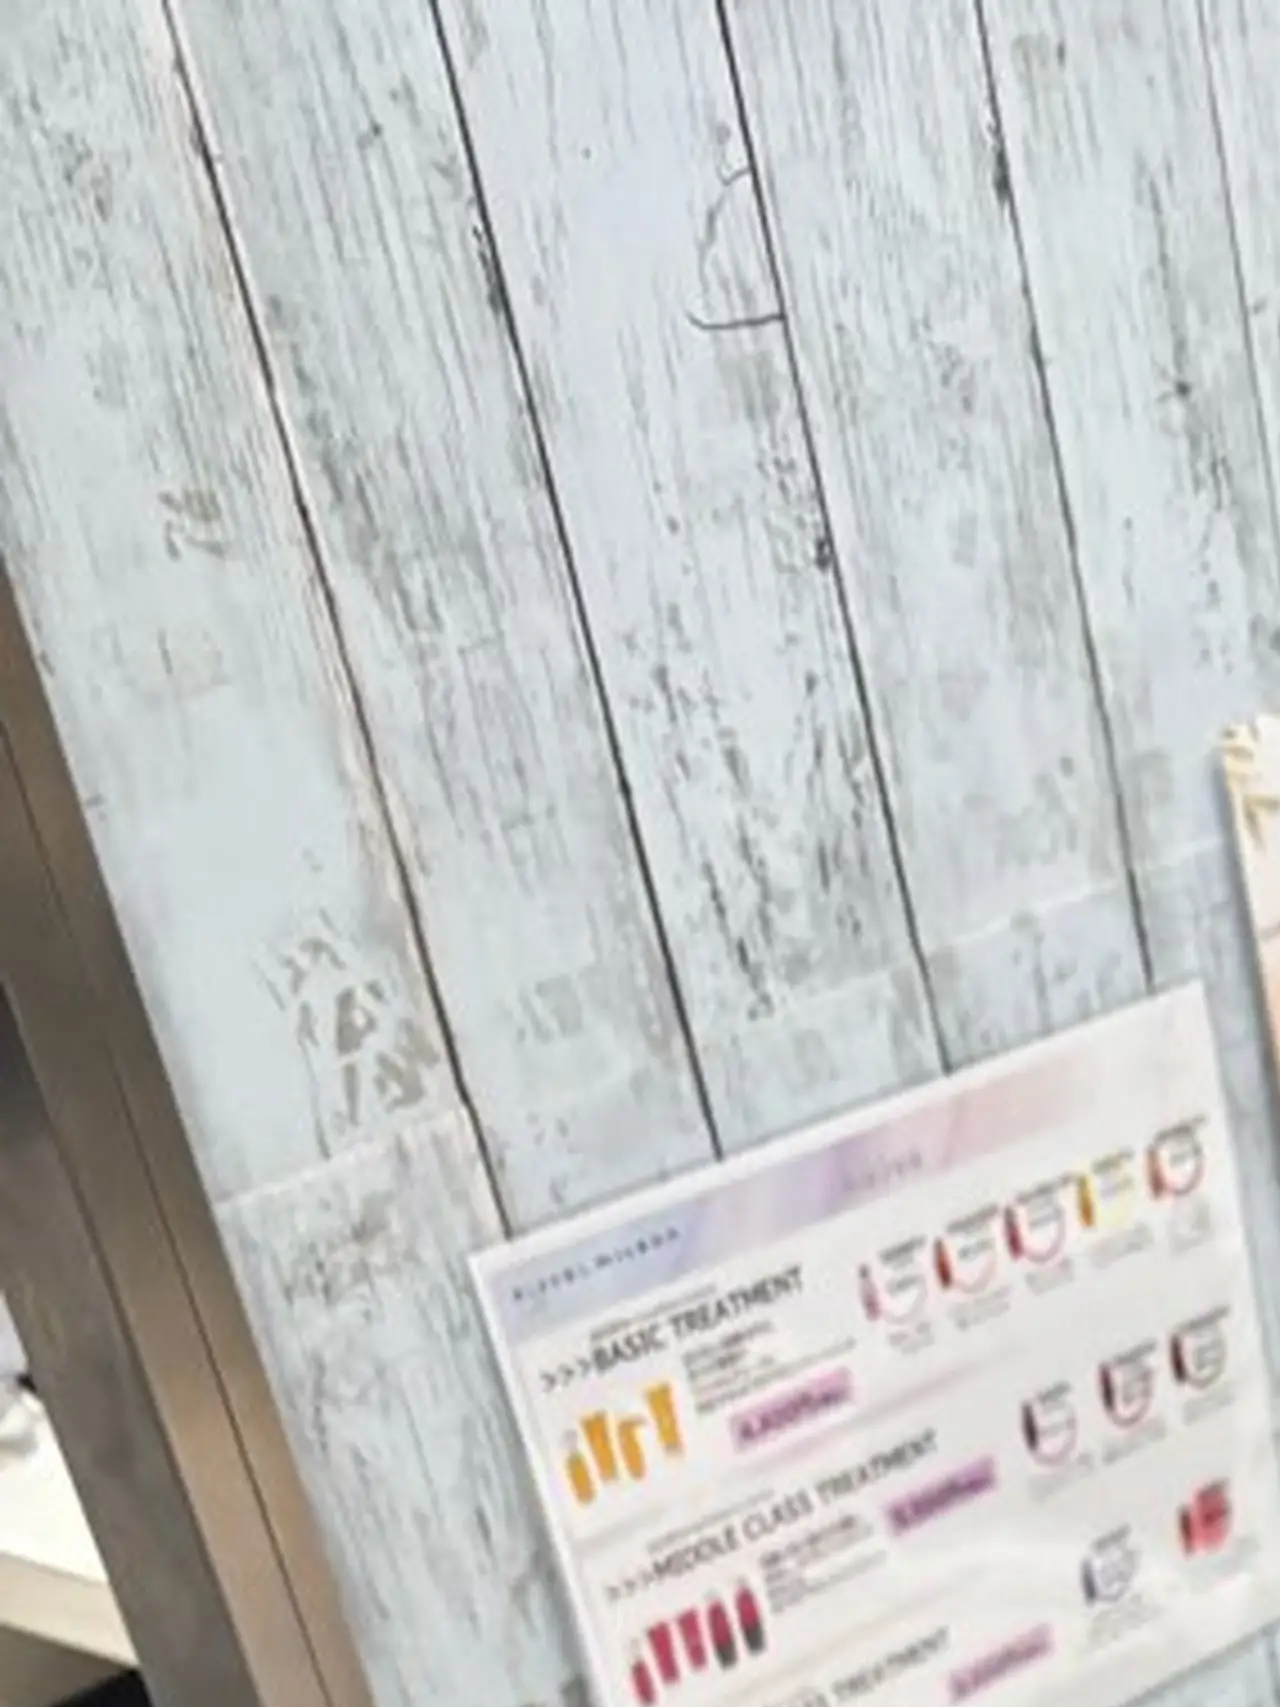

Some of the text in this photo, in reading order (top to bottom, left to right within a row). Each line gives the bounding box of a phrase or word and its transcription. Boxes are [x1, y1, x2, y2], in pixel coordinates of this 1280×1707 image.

[593, 1324, 668, 1373] BASIC
[671, 1264, 805, 1342] TREATMENT
[742, 1488, 816, 1549] CLASS
[816, 1427, 938, 1506] TREATMENT
